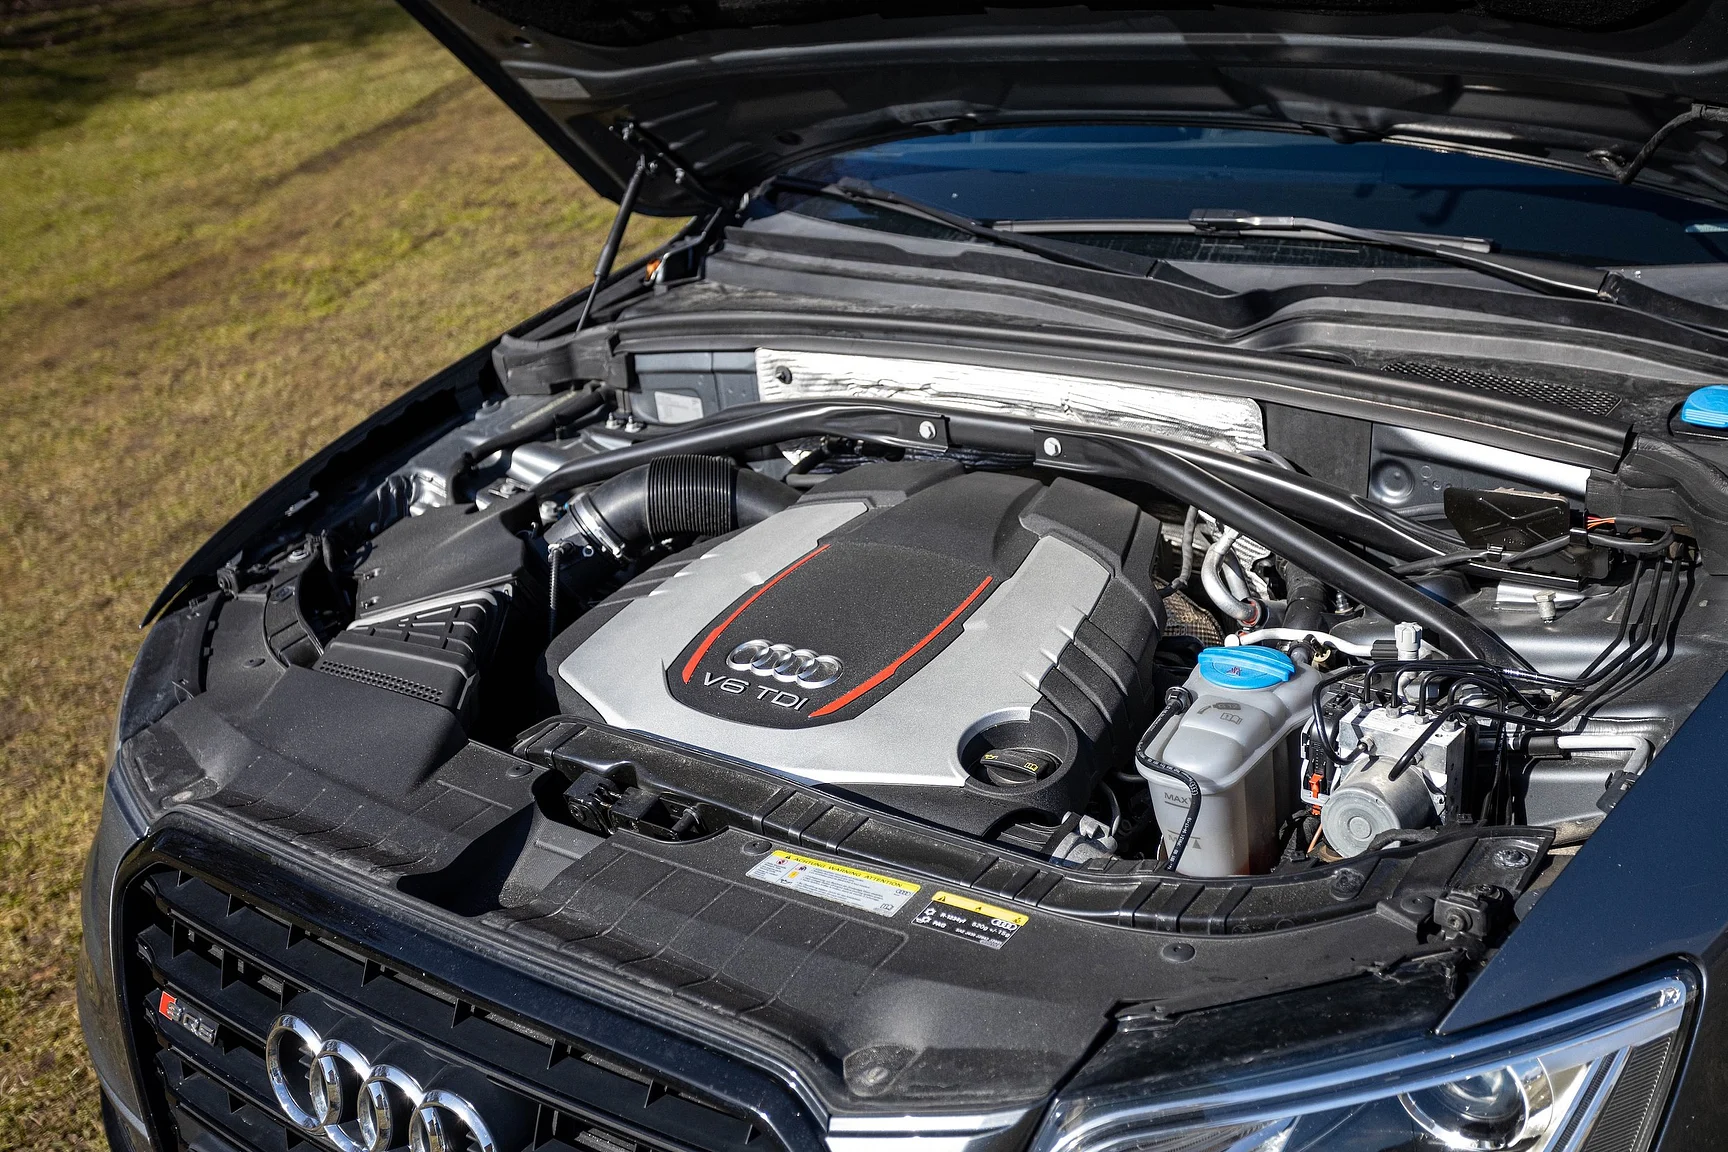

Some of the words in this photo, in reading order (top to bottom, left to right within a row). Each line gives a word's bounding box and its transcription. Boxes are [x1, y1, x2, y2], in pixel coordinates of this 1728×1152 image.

[703, 672, 749, 693] V6
[756, 685, 808, 710] TDI
[1164, 792, 1188, 804] MAX
[794, 858, 826, 869] ACHTUNG
[828, 865, 861, 877] WARNING
[864, 874, 903, 888] ATTENTION
